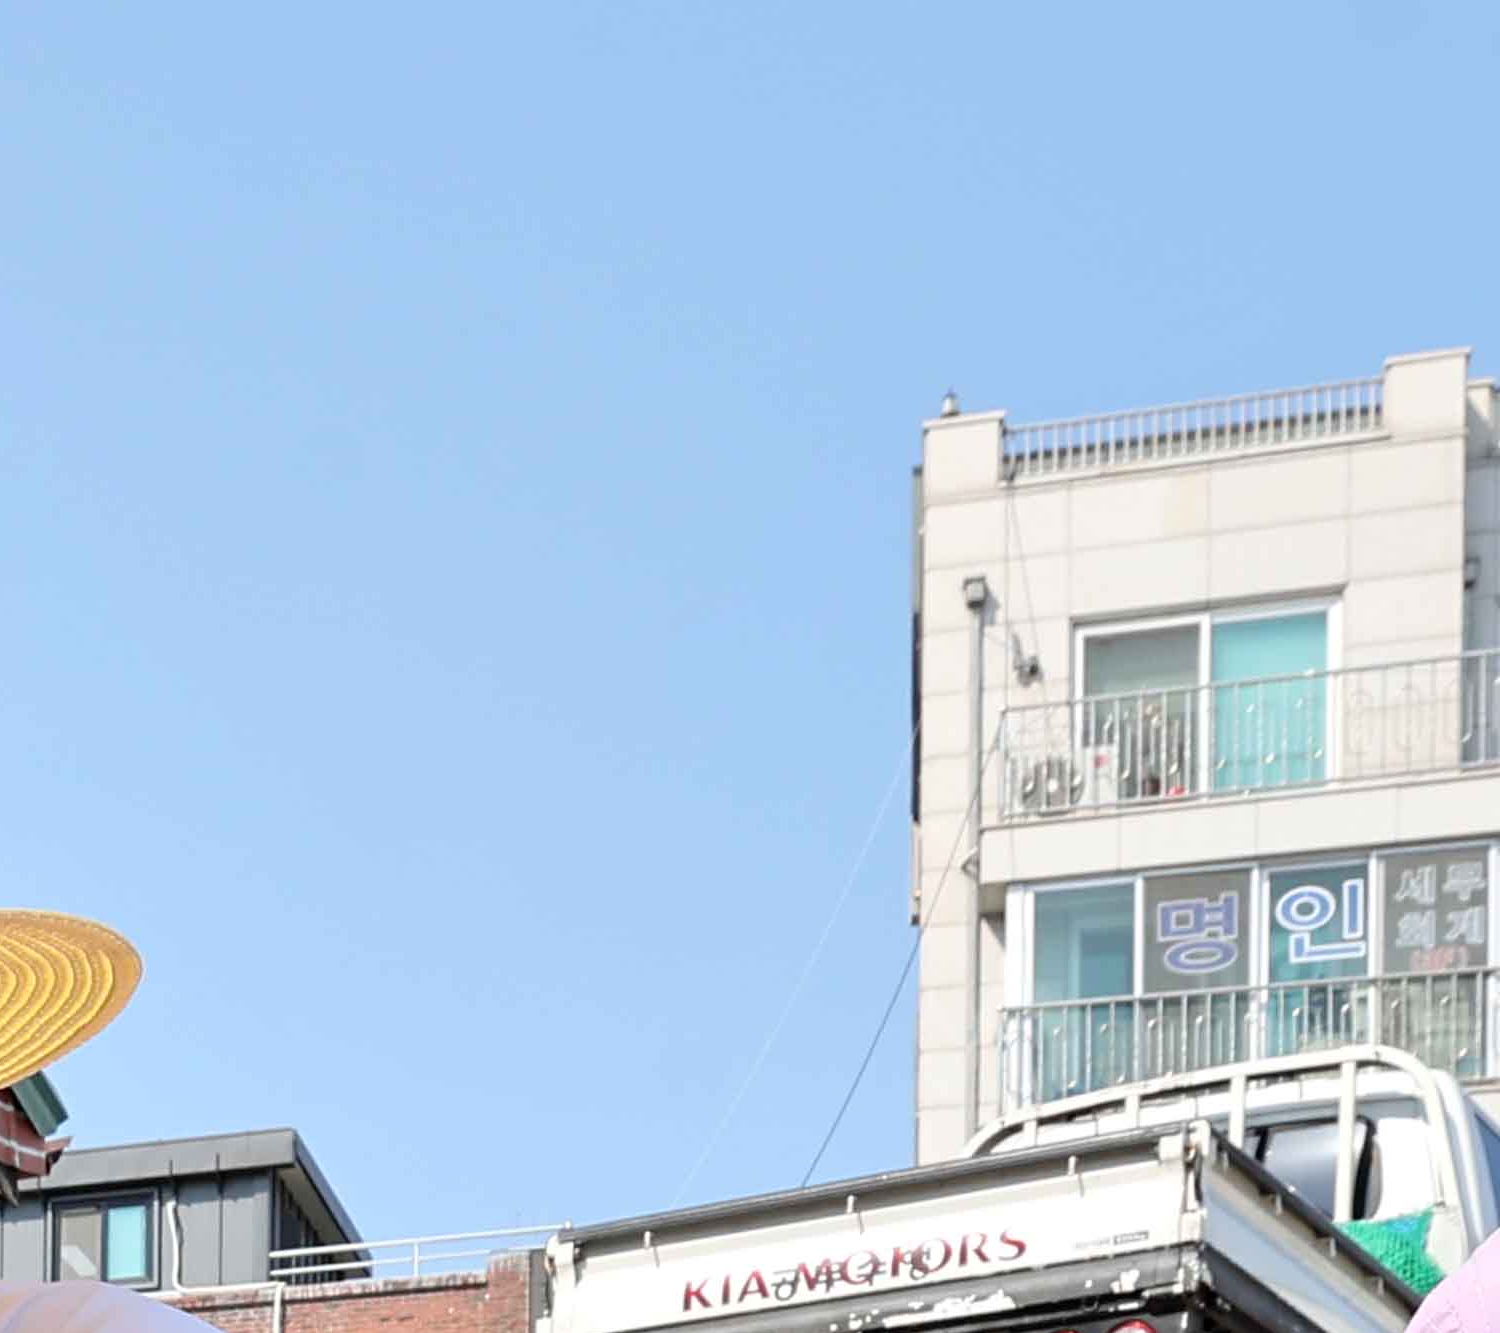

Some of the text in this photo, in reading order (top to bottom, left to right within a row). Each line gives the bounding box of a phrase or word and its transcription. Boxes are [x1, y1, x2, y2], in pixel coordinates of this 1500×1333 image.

[1156, 878, 1367, 974] 명인
[683, 1230, 1027, 1312] KIA MOTORS
